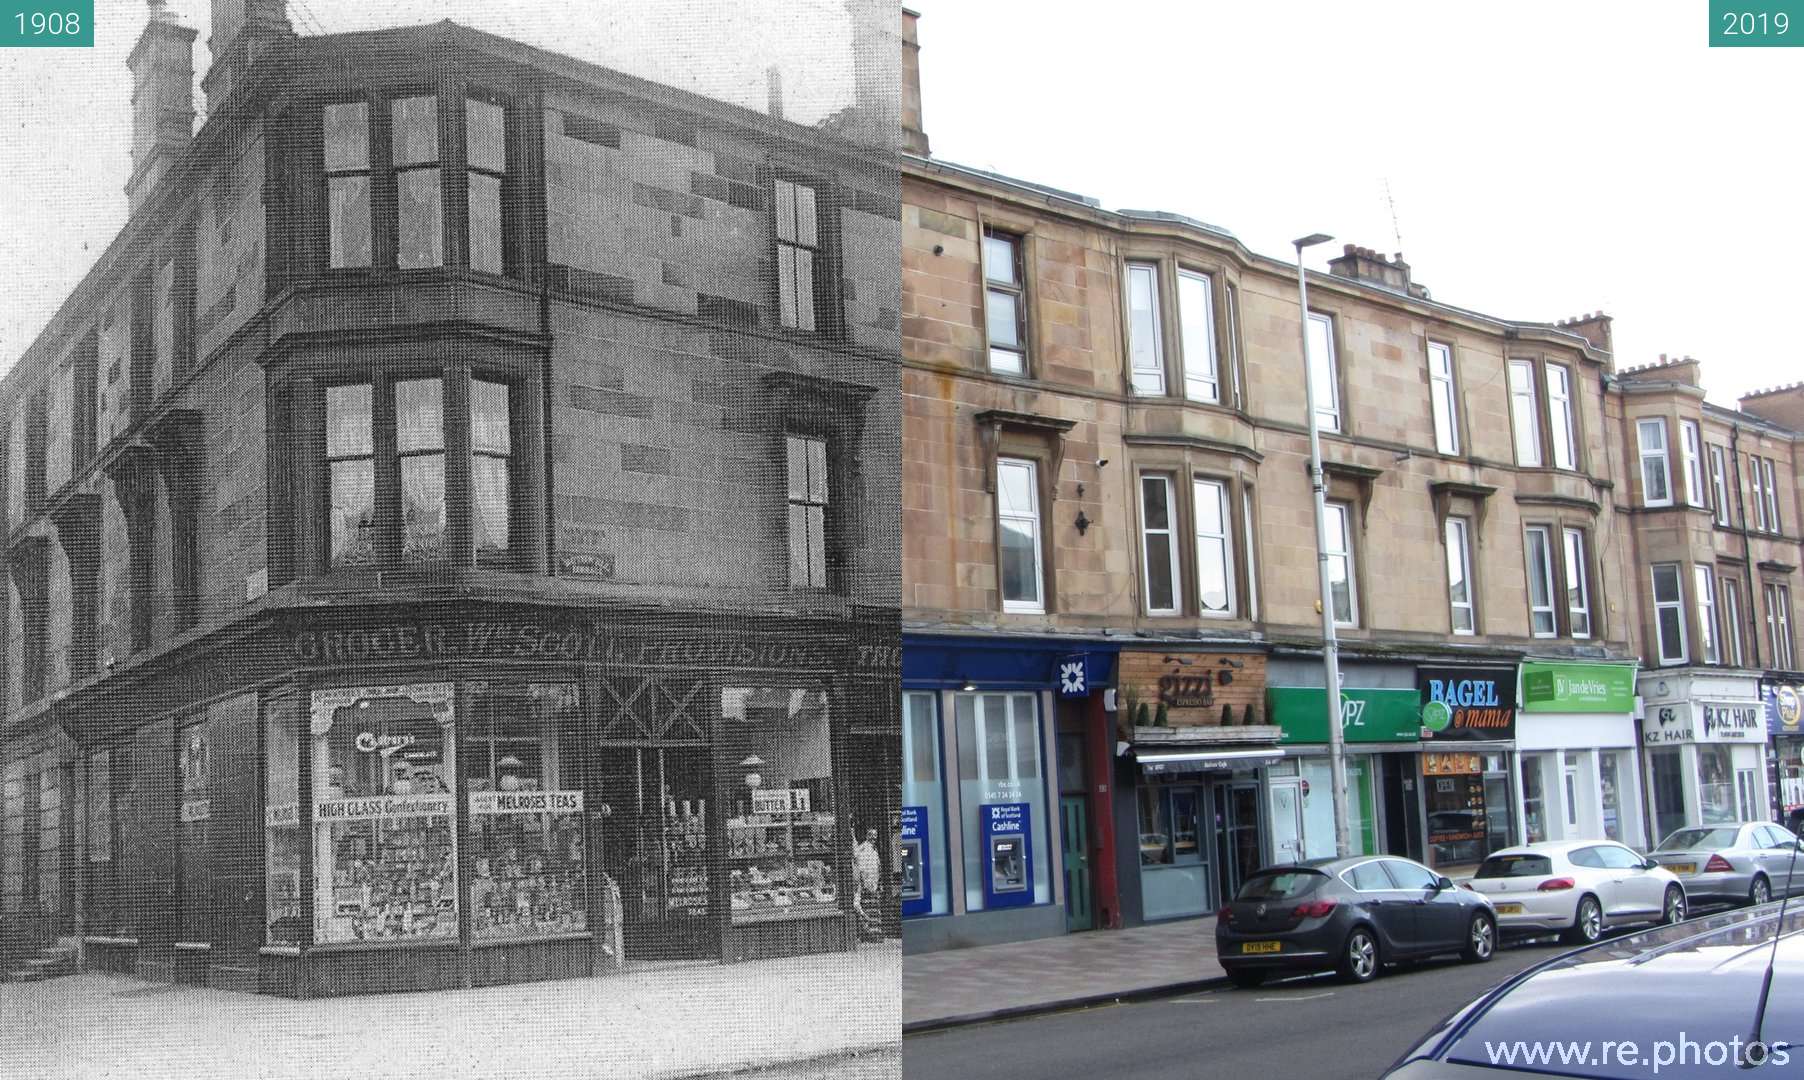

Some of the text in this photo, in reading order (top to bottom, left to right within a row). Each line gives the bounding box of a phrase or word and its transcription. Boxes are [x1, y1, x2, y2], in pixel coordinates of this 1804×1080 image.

[1429, 679, 1498, 706] BAGEL
[1717, 708, 1758, 729] KZ HAIR
[1645, 730, 1694, 743] KZ HAIR
[319, 802, 345, 817] HIGH
[347, 800, 382, 816] CLASS
[497, 795, 546, 810] MELROSES
[549, 794, 577, 808] TEAS
[992, 821, 1020, 831] Cashline
